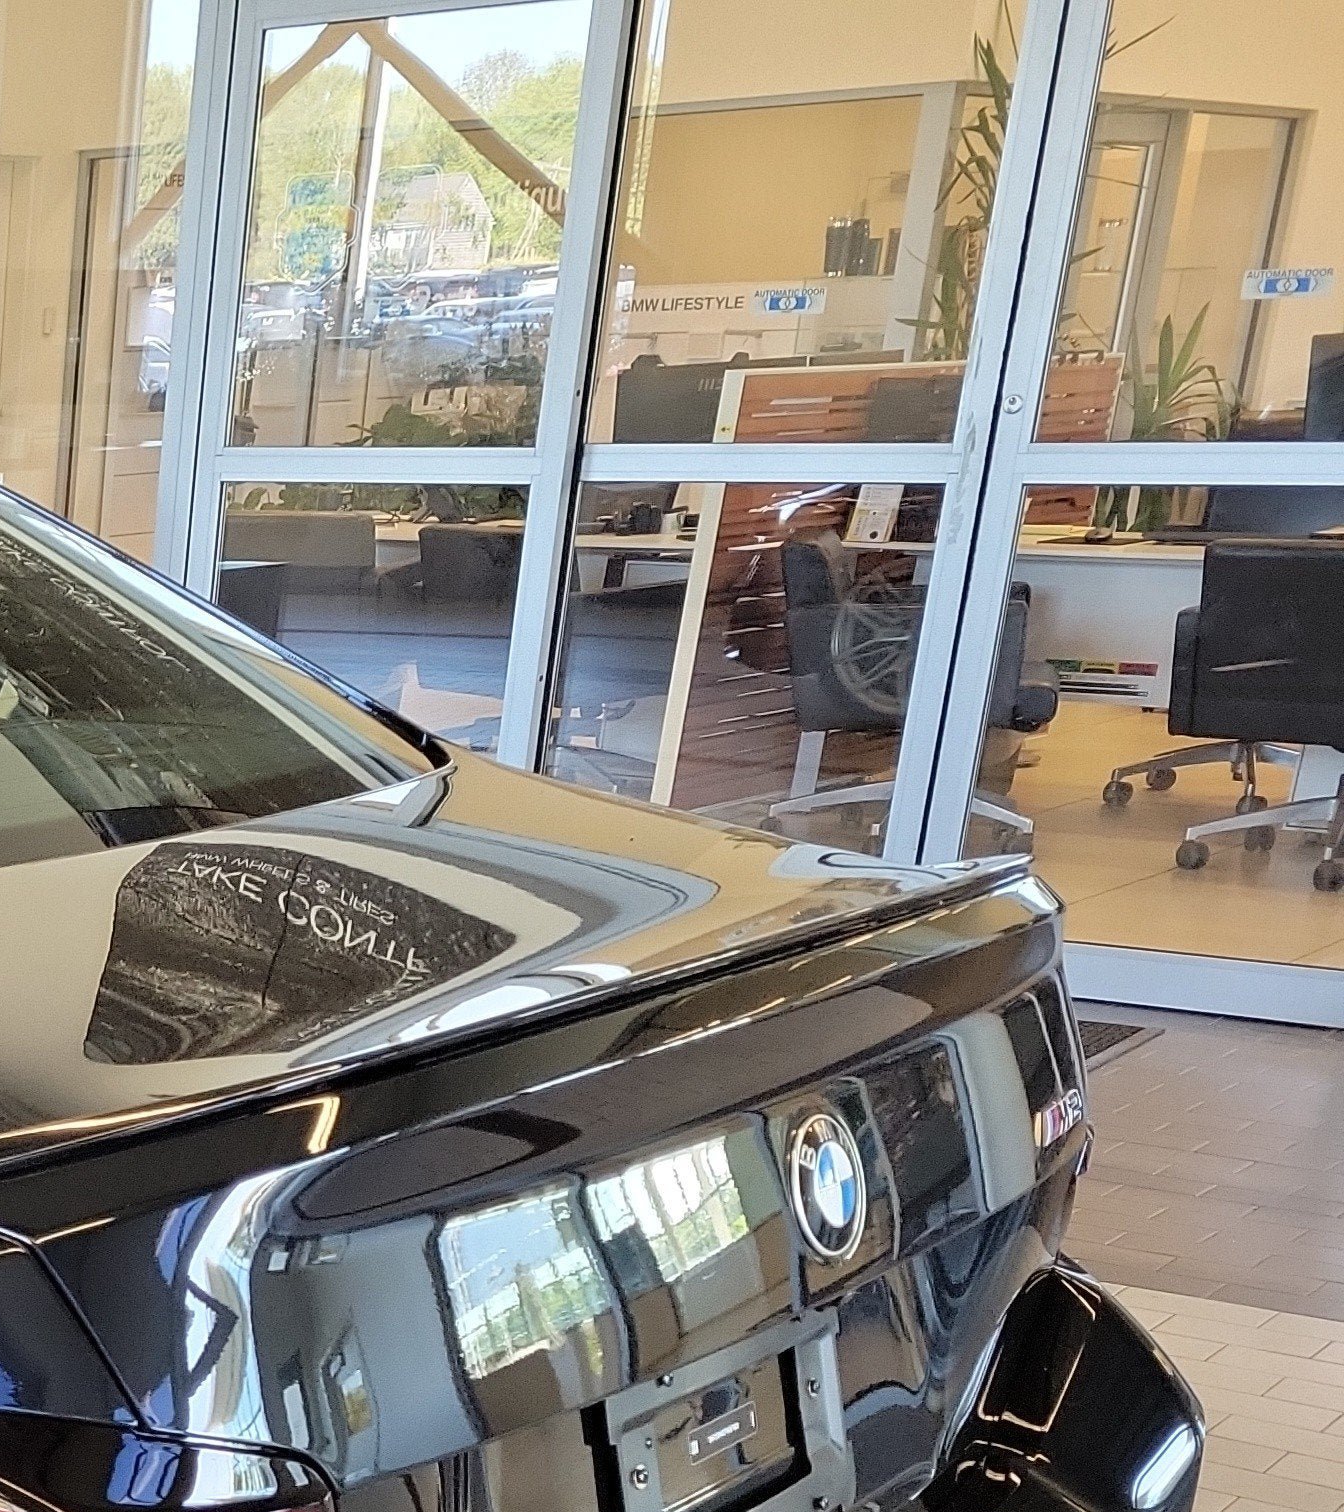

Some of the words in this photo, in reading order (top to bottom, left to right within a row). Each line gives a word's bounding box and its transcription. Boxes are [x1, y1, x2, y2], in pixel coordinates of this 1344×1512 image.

[1247, 269, 1303, 279] AUTOMATIC
[1305, 267, 1334, 277] DOOR
[754, 289, 800, 298] AUTOMATIC
[801, 288, 825, 296] DOOR
[621, 298, 659, 313] BMW
[662, 296, 745, 311] LIFESTYLE
